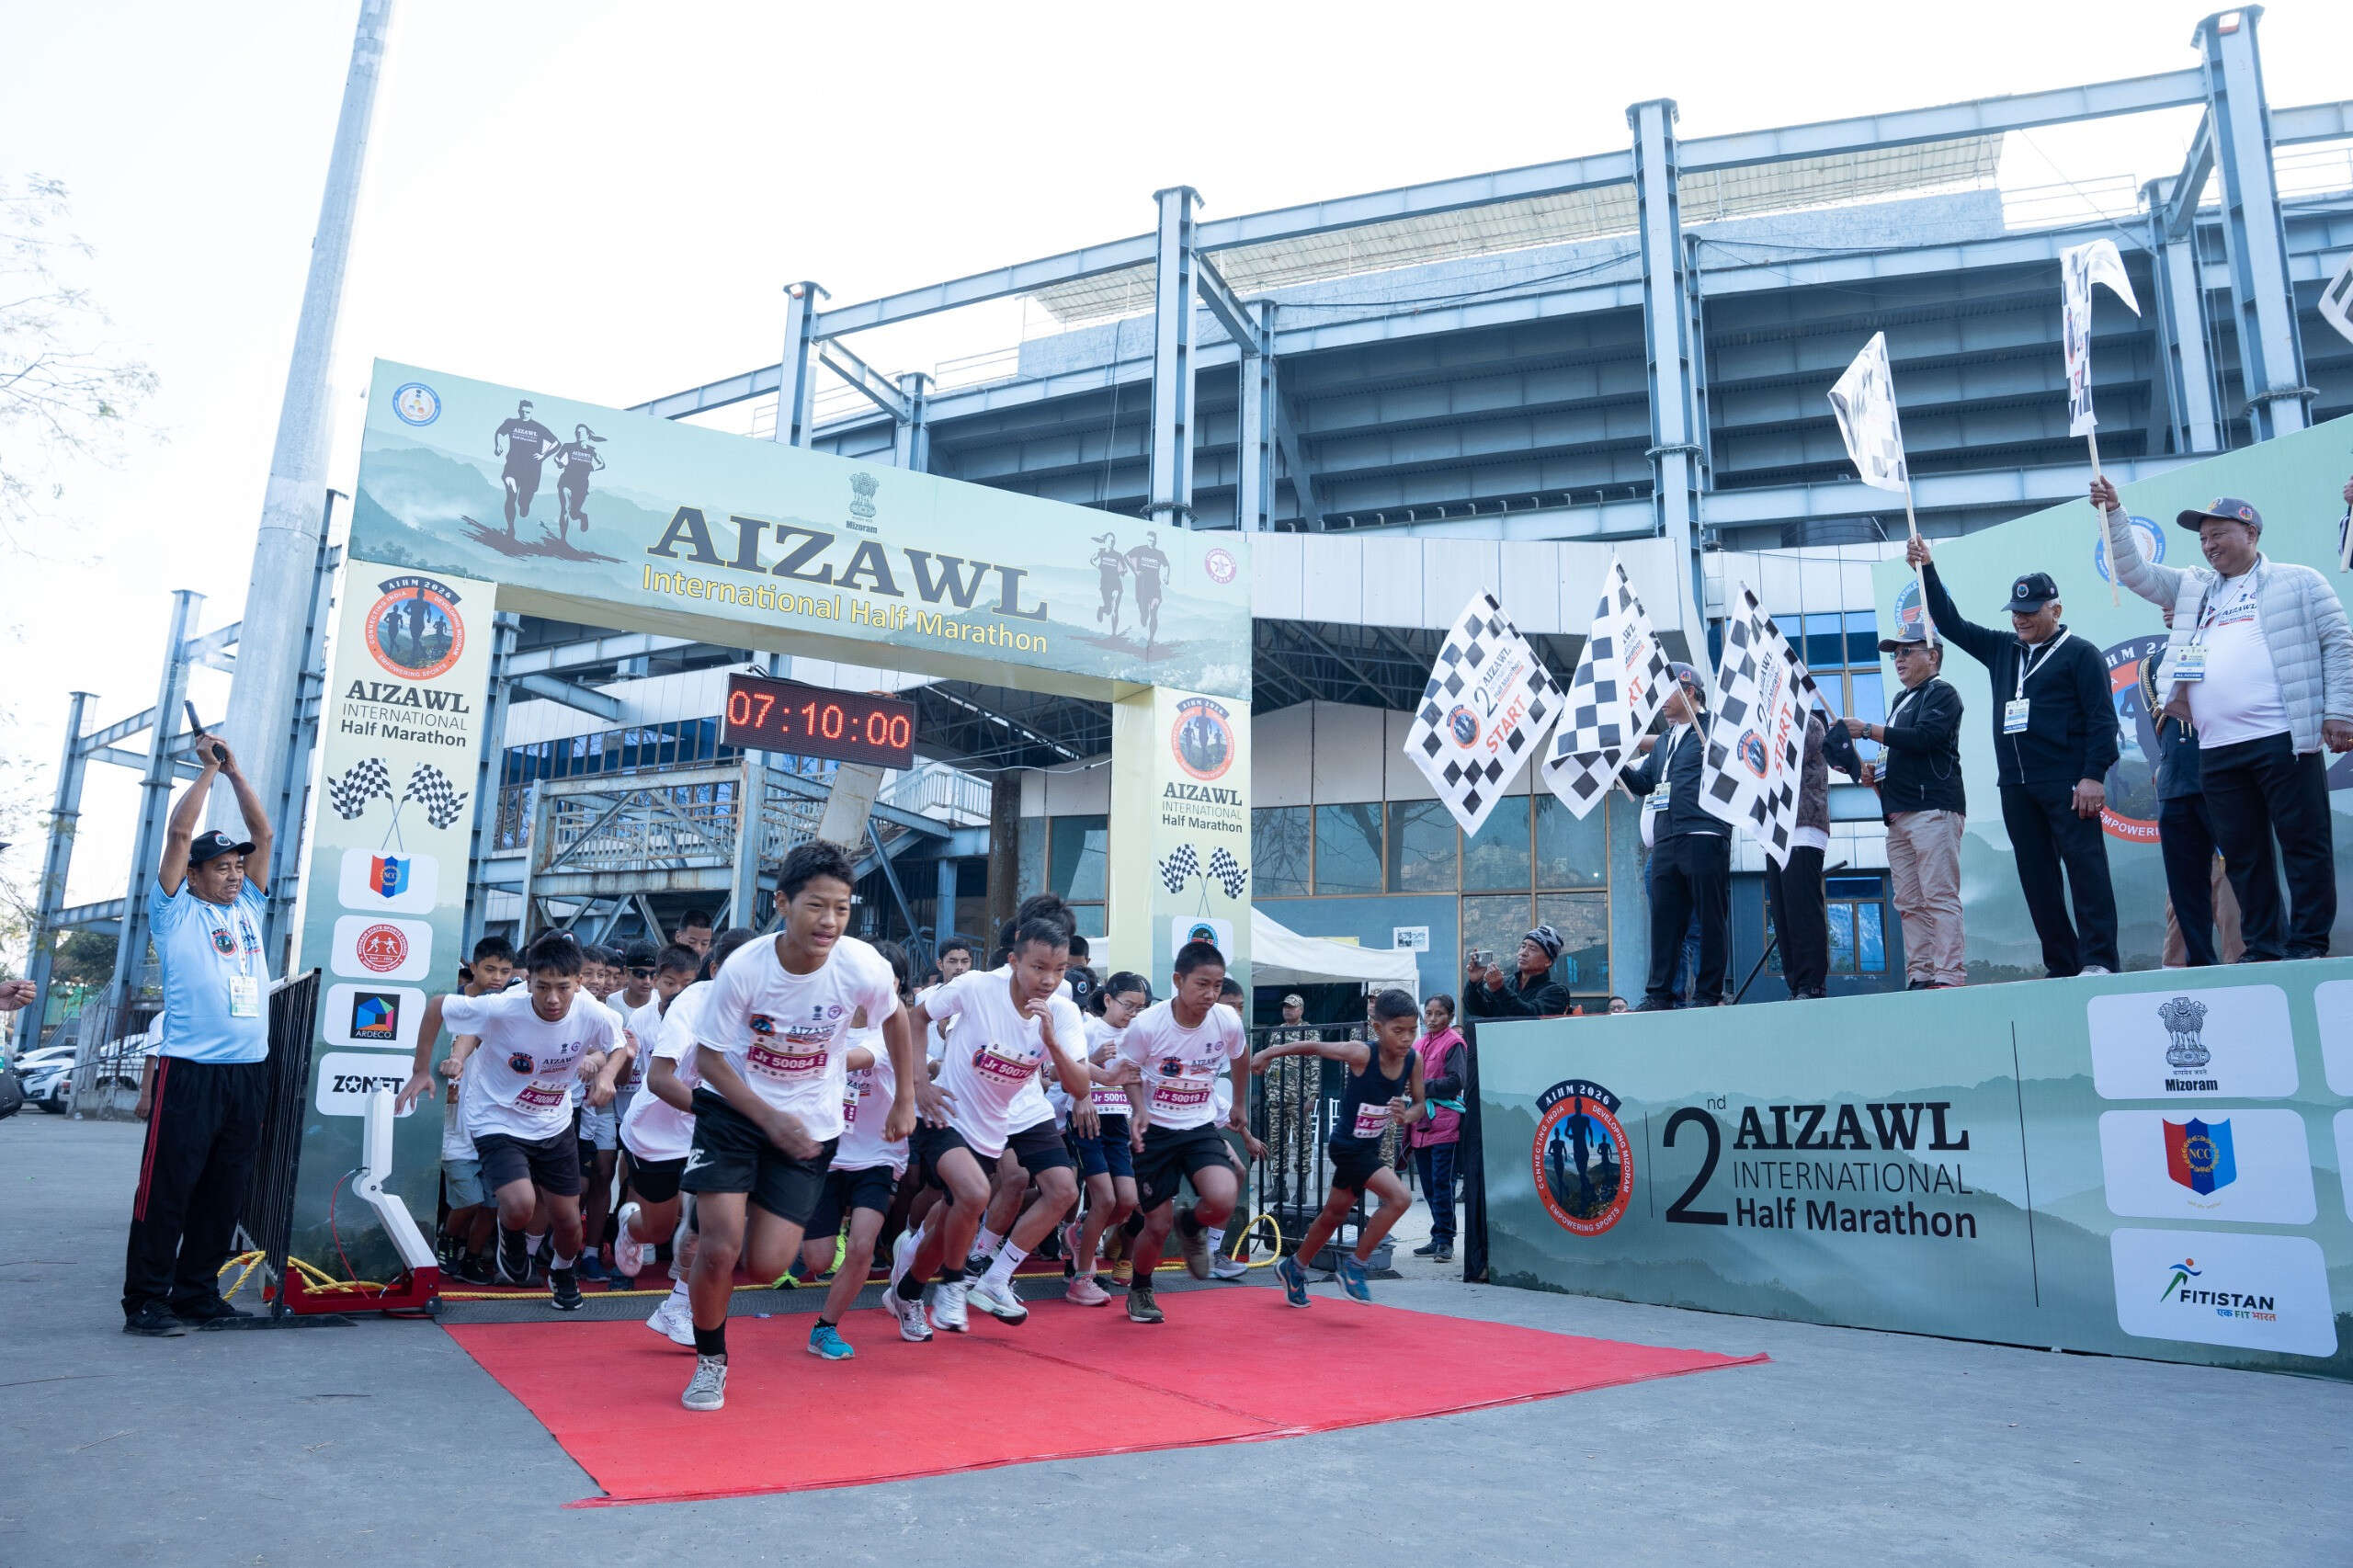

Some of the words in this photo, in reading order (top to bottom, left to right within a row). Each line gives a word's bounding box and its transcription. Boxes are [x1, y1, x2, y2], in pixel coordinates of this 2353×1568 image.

[846, 520, 877, 533] Mizoram
[646, 506, 1048, 621] AIZAWL
[388, 579, 419, 590] AIHM
[425, 581, 451, 598] 2026
[642, 563, 841, 620] International
[850, 599, 908, 631] Half
[916, 610, 1048, 654] Marathon
[1483, 647, 1512, 687] AIZAWL
[346, 680, 470, 713] AIZAWL
[342, 703, 468, 731] INTERNATIONAL
[728, 690, 911, 749] 07:10:00
[1486, 694, 1526, 755] START
[341, 719, 377, 736] Half
[382, 724, 466, 747] Marathon
[1774, 701, 1792, 777] START
[1163, 782, 1243, 807] AIZAWL
[1162, 801, 1243, 820] INTERNATIONAL
[1163, 814, 1186, 827] Half
[1188, 816, 1243, 833] Marathon
[755, 1051, 770, 1062] Jr
[984, 1059, 998, 1070] Jr
[1105, 1094, 1127, 1102] 50013
[1171, 1094, 1200, 1103] 50019
[1544, 1085, 1574, 1107] AIHM
[1579, 1085, 1610, 1105] 2026
[2165, 1079, 2219, 1092] Mizoram
[1733, 1101, 1970, 1151] AIZAWL
[1535, 1125, 1548, 1189] CONNECTING
[1546, 1105, 1564, 1124] INDIA
[1592, 1105, 1626, 1149] DEVELOPING
[1621, 1150, 1632, 1193] MIZORAM
[2189, 1149, 2211, 1160] NCC
[1733, 1161, 1973, 1195] INTERNATIONAL
[1550, 1204, 1594, 1232] EMPOWERING
[1596, 1207, 1620, 1230] SPORTS
[1735, 1197, 1796, 1230] Half
[1806, 1199, 1978, 1239] Marathon
[2180, 1289, 2274, 1311] FITISTAN
[2217, 1309, 2234, 1318] एक
[2234, 1311, 2250, 1320] FIT
[2252, 1312, 2278, 1322] भारत
